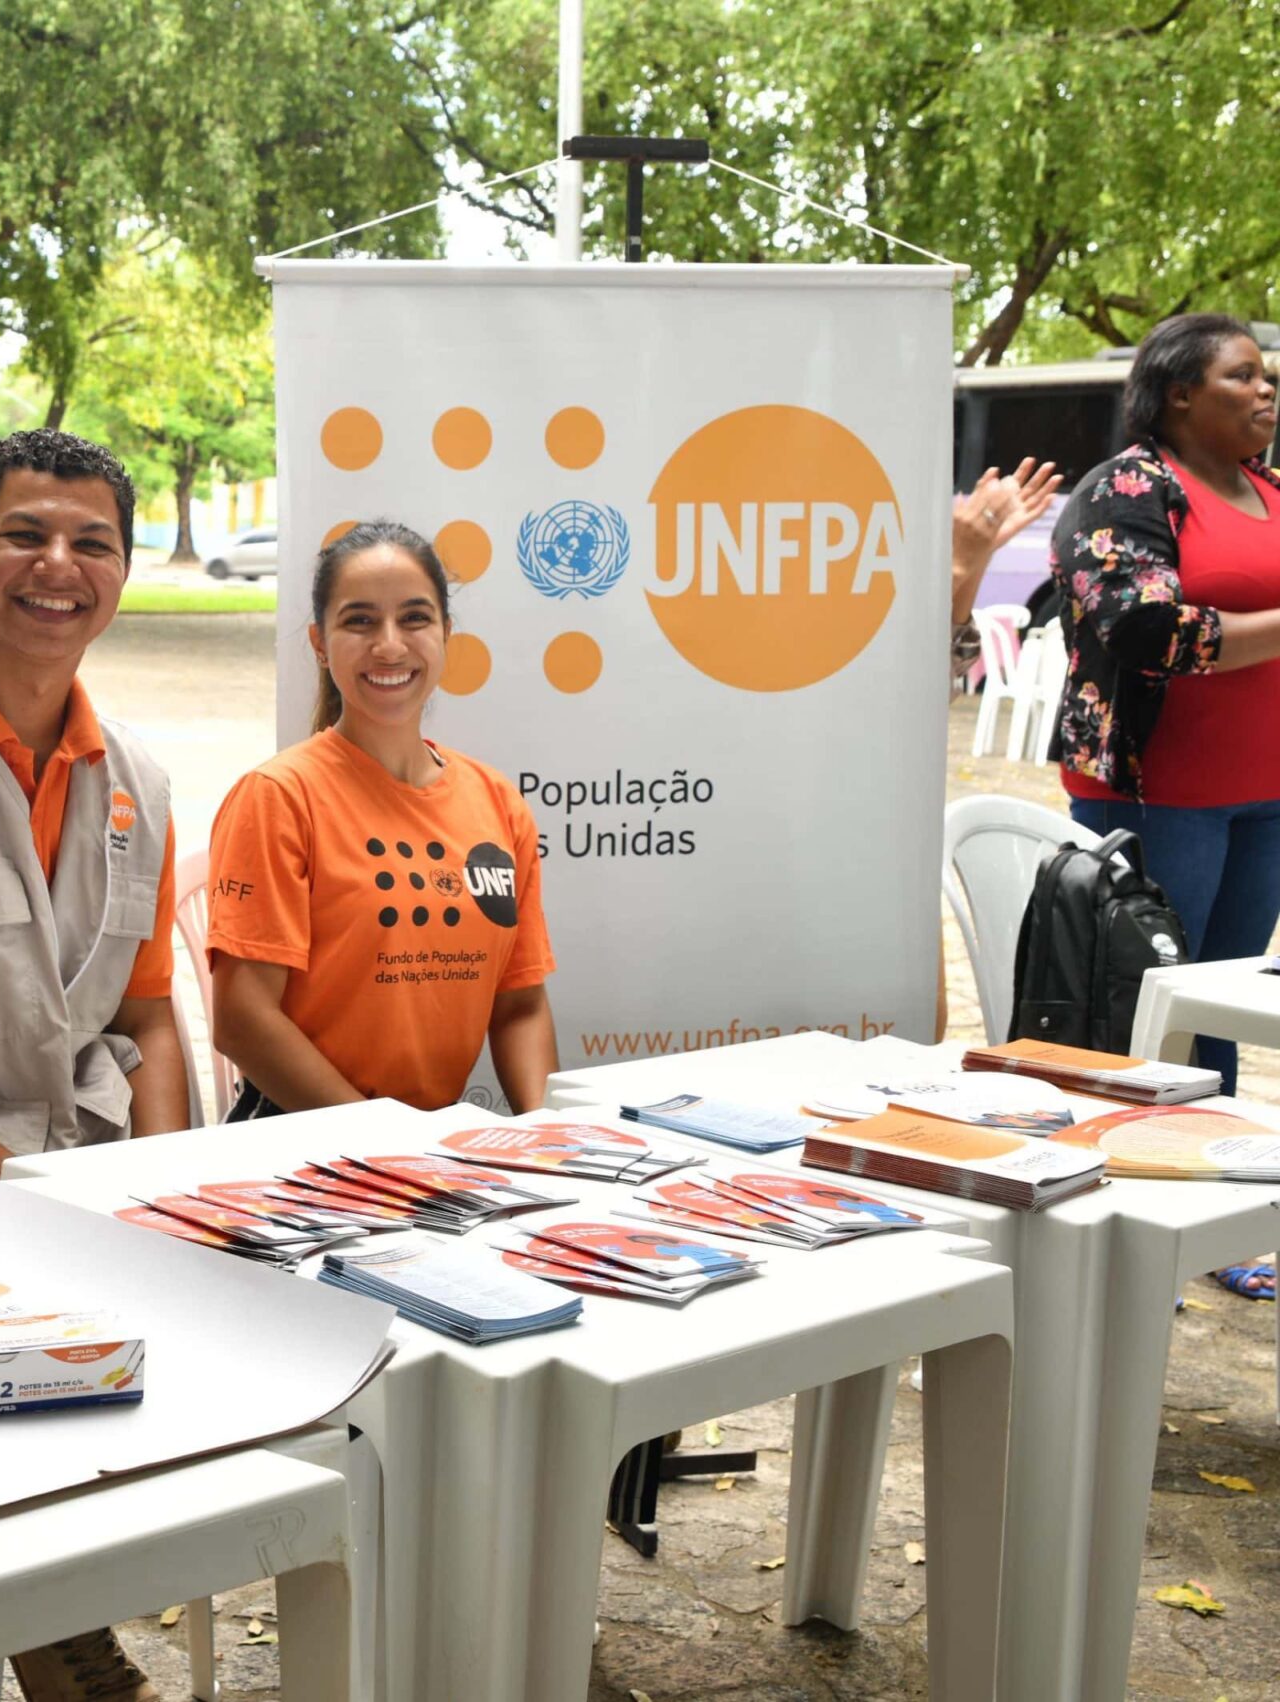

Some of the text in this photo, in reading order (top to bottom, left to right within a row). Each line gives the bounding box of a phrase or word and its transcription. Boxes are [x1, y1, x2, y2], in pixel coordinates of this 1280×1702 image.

[644, 501, 904, 597] UNFPA
[519, 769, 714, 814] População
[565, 822, 697, 858] Unidas
[377, 950, 488, 966] Fundo de População
[375, 968, 480, 985] das Nações Unidas
